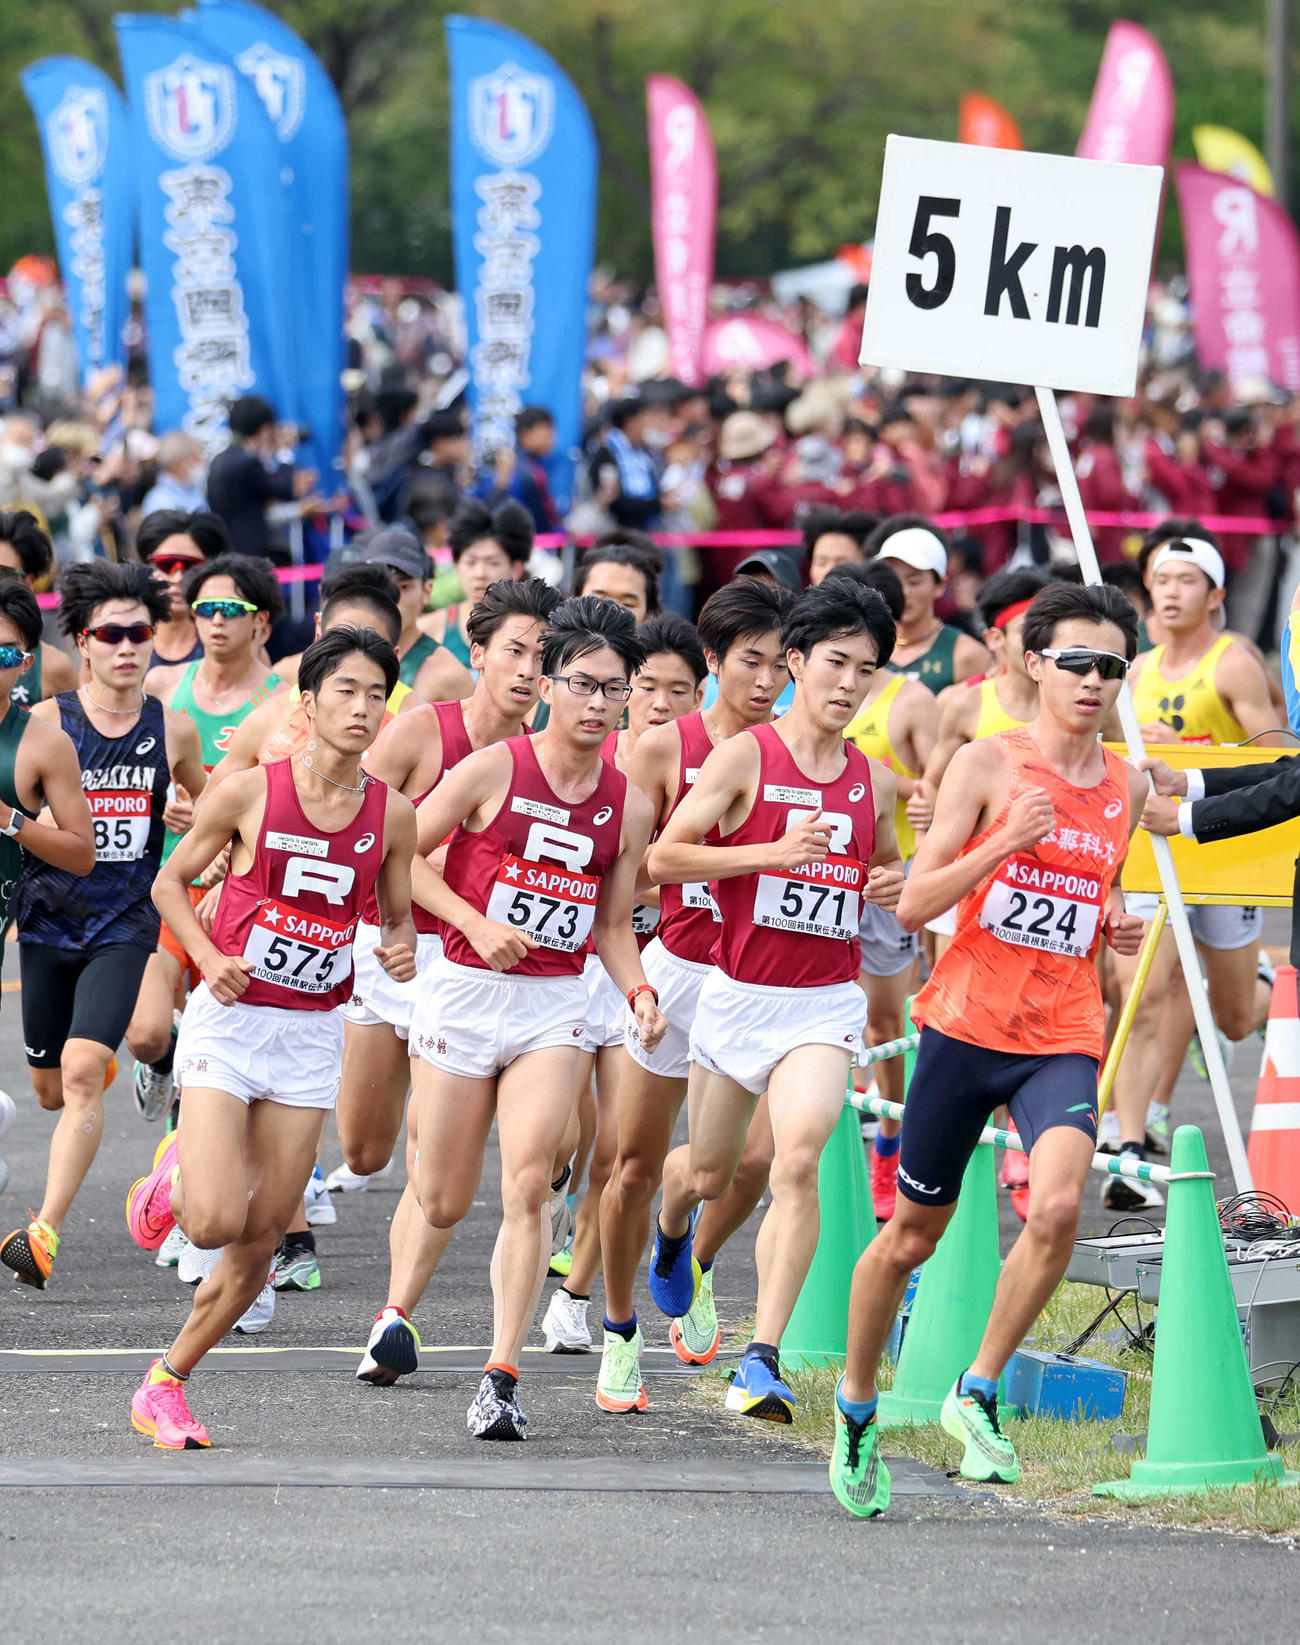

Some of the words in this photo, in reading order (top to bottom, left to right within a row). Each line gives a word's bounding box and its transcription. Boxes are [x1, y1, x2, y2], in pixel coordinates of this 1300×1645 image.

[906, 195, 961, 310] 5
[984, 206, 1106, 328] km
[81, 765, 156, 791] OGAKKAN
[86, 797, 147, 813] PPORO
[523, 822, 594, 874] R
[282, 856, 356, 905] R
[524, 869, 597, 900] SAPPORO
[789, 862, 860, 885] SAPPORO
[1017, 866, 1099, 899] SAPPORO
[507, 891, 579, 938] 573
[780, 881, 846, 926] 571
[1001, 892, 1078, 941] 224
[761, 915, 852, 939] 第100回箱根駅伝予選会
[264, 936, 339, 982] 575
